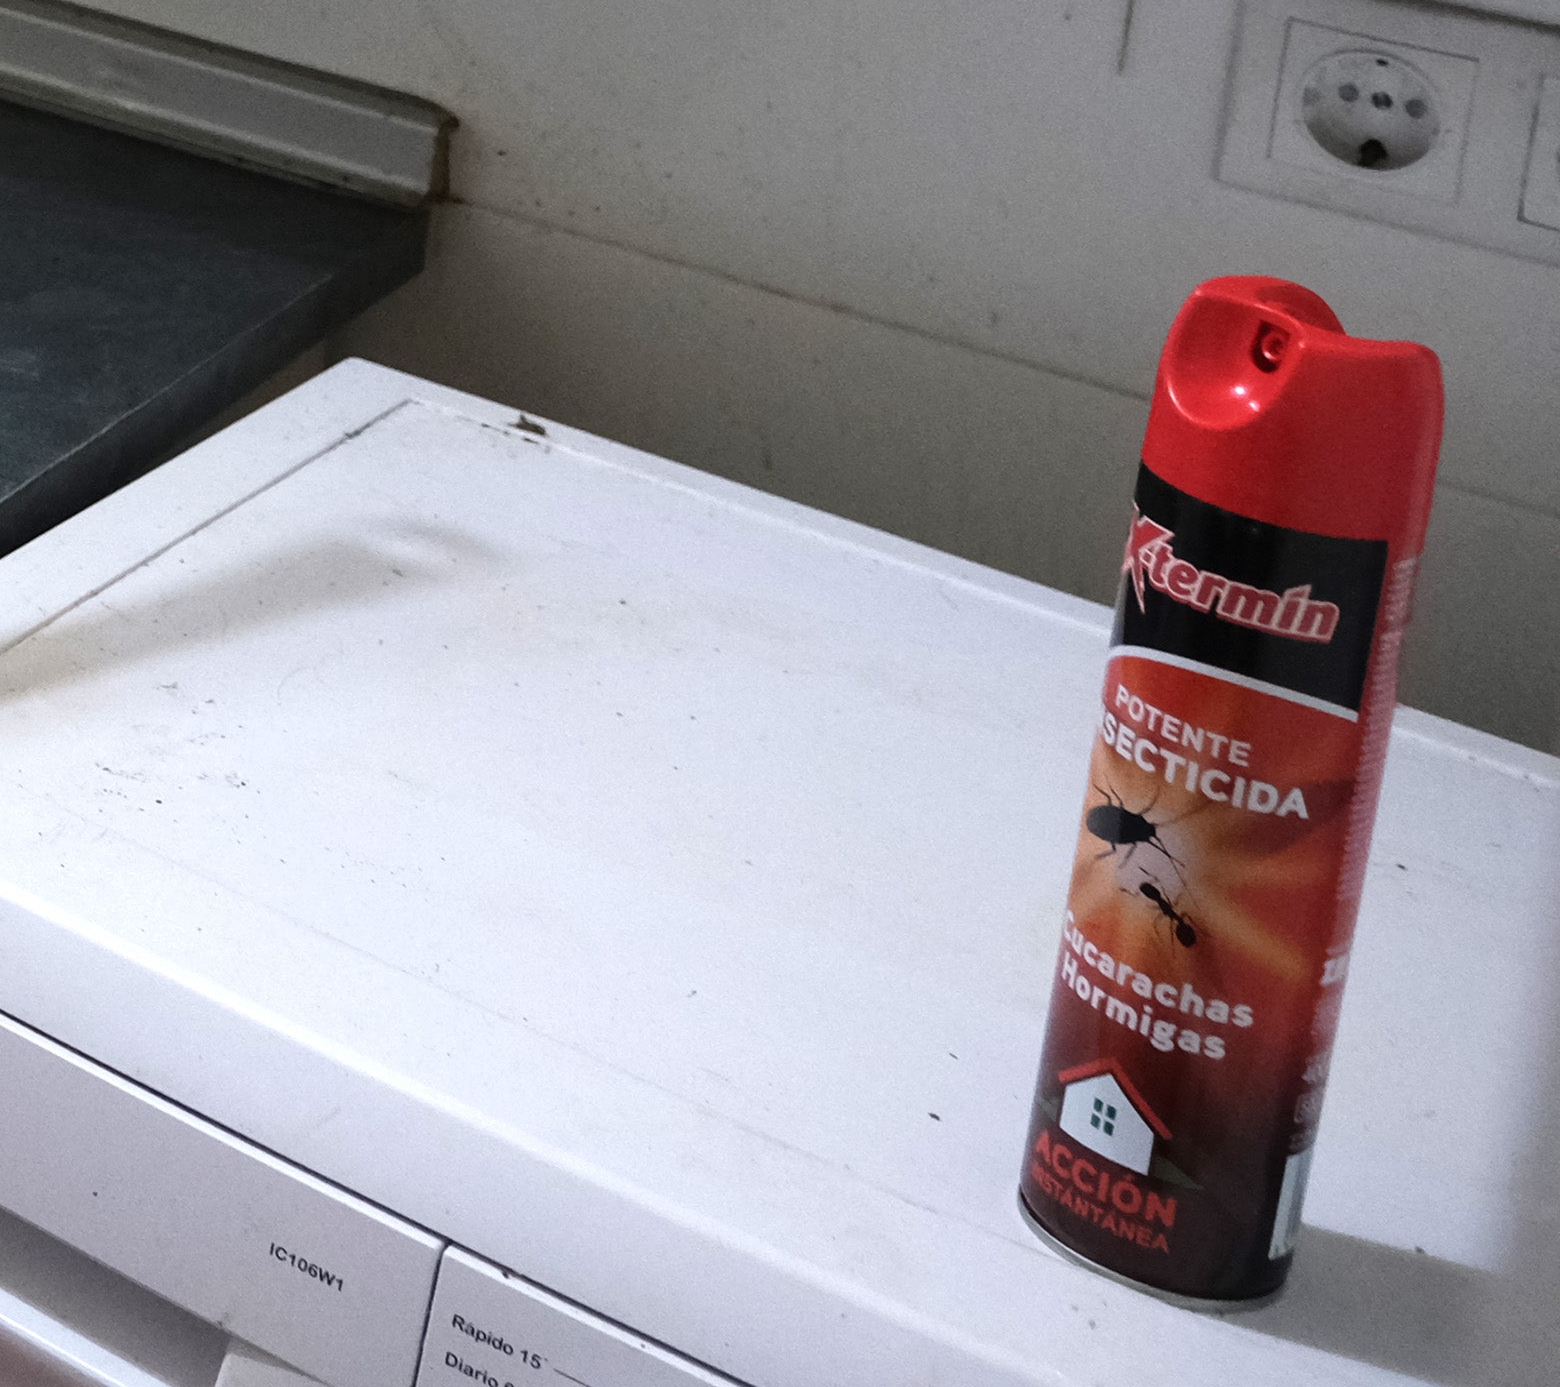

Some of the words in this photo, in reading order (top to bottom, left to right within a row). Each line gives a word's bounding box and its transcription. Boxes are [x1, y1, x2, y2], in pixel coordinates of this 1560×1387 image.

[1101, 710, 1310, 820] SECTICIDA
[1115, 683, 1252, 768] POTENTE
[1061, 949, 1226, 1060] Hormigas
[1063, 909, 1254, 1028] Cucarachas
[1036, 1130, 1178, 1227] ACCIÓN
[269, 1242, 344, 1292] IC106W1
[445, 1351, 499, 1387] Diario
[451, 1313, 514, 1356] Rápido
